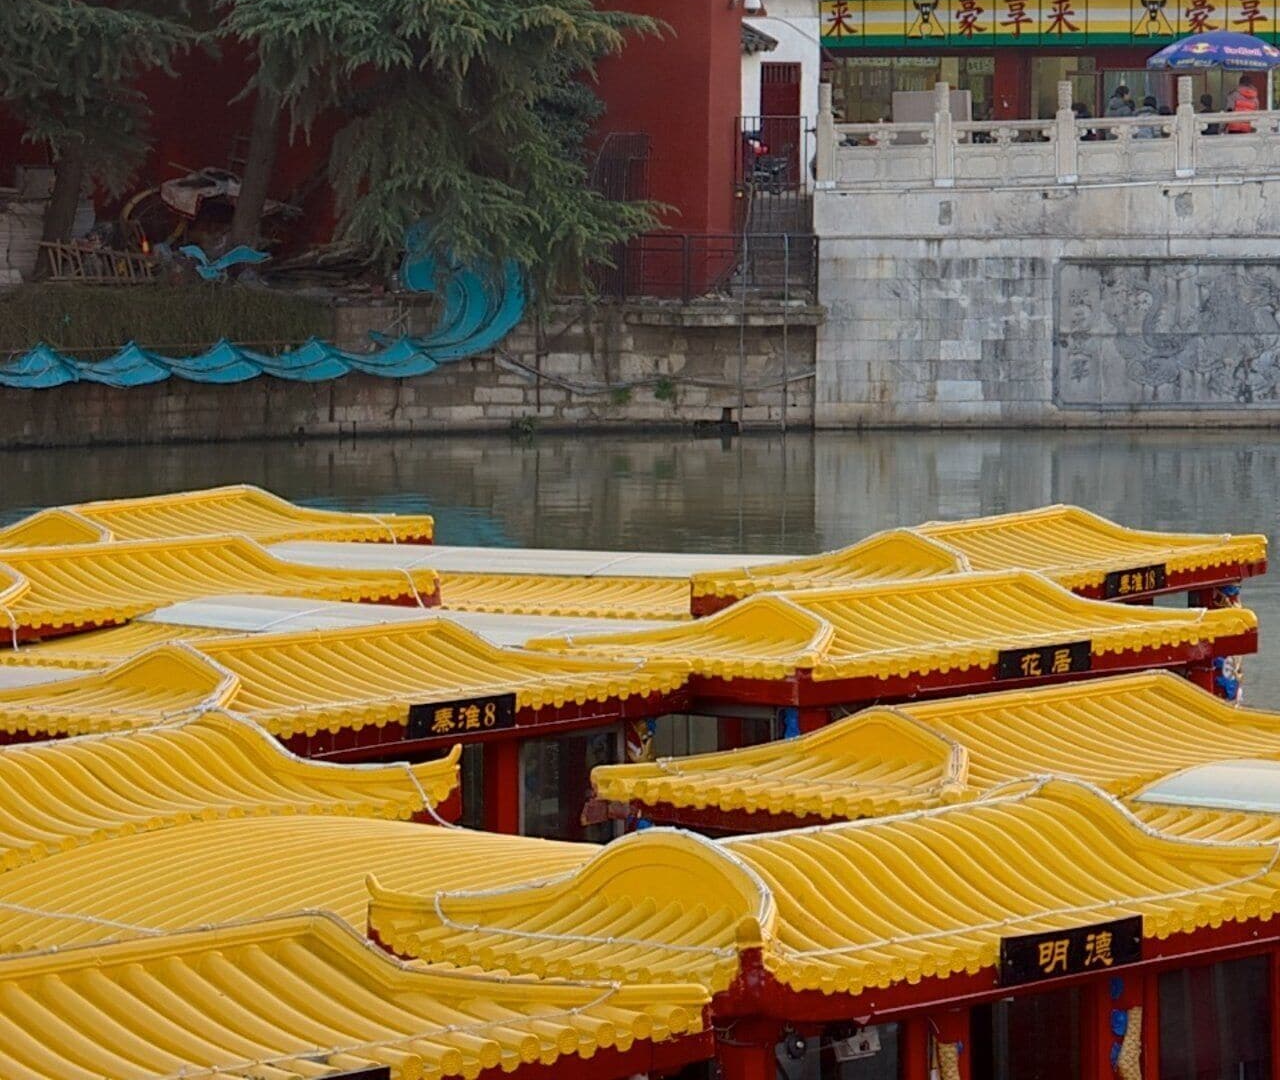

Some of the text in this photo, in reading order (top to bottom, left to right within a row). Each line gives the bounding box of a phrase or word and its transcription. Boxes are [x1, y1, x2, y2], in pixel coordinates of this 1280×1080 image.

[825, 0, 858, 38] 来
[1020, 648, 1073, 676] 花居
[431, 702, 496, 734] 秦淮8
[1038, 930, 1114, 973] 明德
